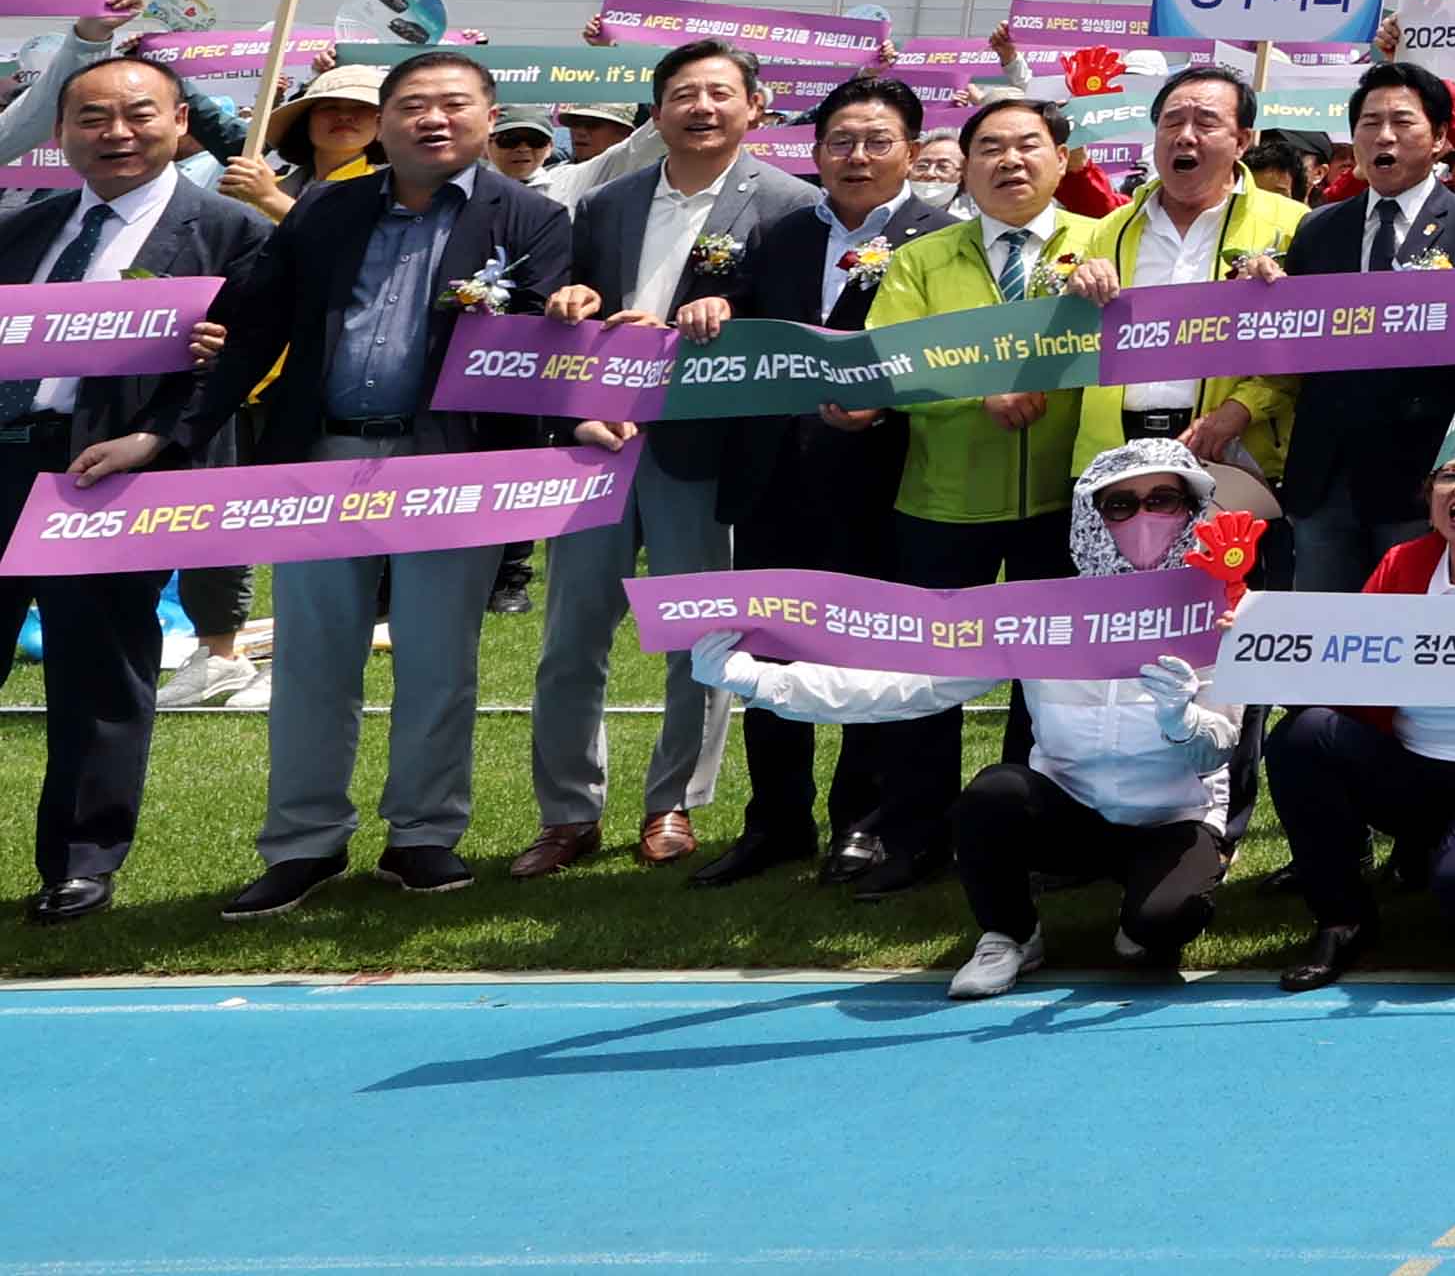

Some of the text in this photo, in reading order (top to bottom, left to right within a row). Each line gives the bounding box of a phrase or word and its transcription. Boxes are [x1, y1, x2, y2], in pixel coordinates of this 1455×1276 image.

[643, 14, 682, 32] APEC
[1081, 105, 1148, 127] APEC
[43, 308, 179, 343] 기원합니다.
[1116, 324, 1171, 351] 2025
[1175, 317, 1230, 345] APEC
[1236, 309, 1325, 341] 정상회의
[1332, 306, 1375, 336] 인천
[1382, 303, 1449, 333] 유치를
[465, 351, 598, 382] 2025 APEC
[681, 325, 1100, 385] 2025 APEC Summit Now, it's Incheo
[41, 472, 613, 540] 2025 APEC 정상회의 인천 유치를 기원합니다.
[659, 597, 1214, 648] 2025 APEC 정상회의 인천 유치를 기원합니다.
[1235, 633, 1313, 662] 2025
[1322, 635, 1403, 664] APEC
